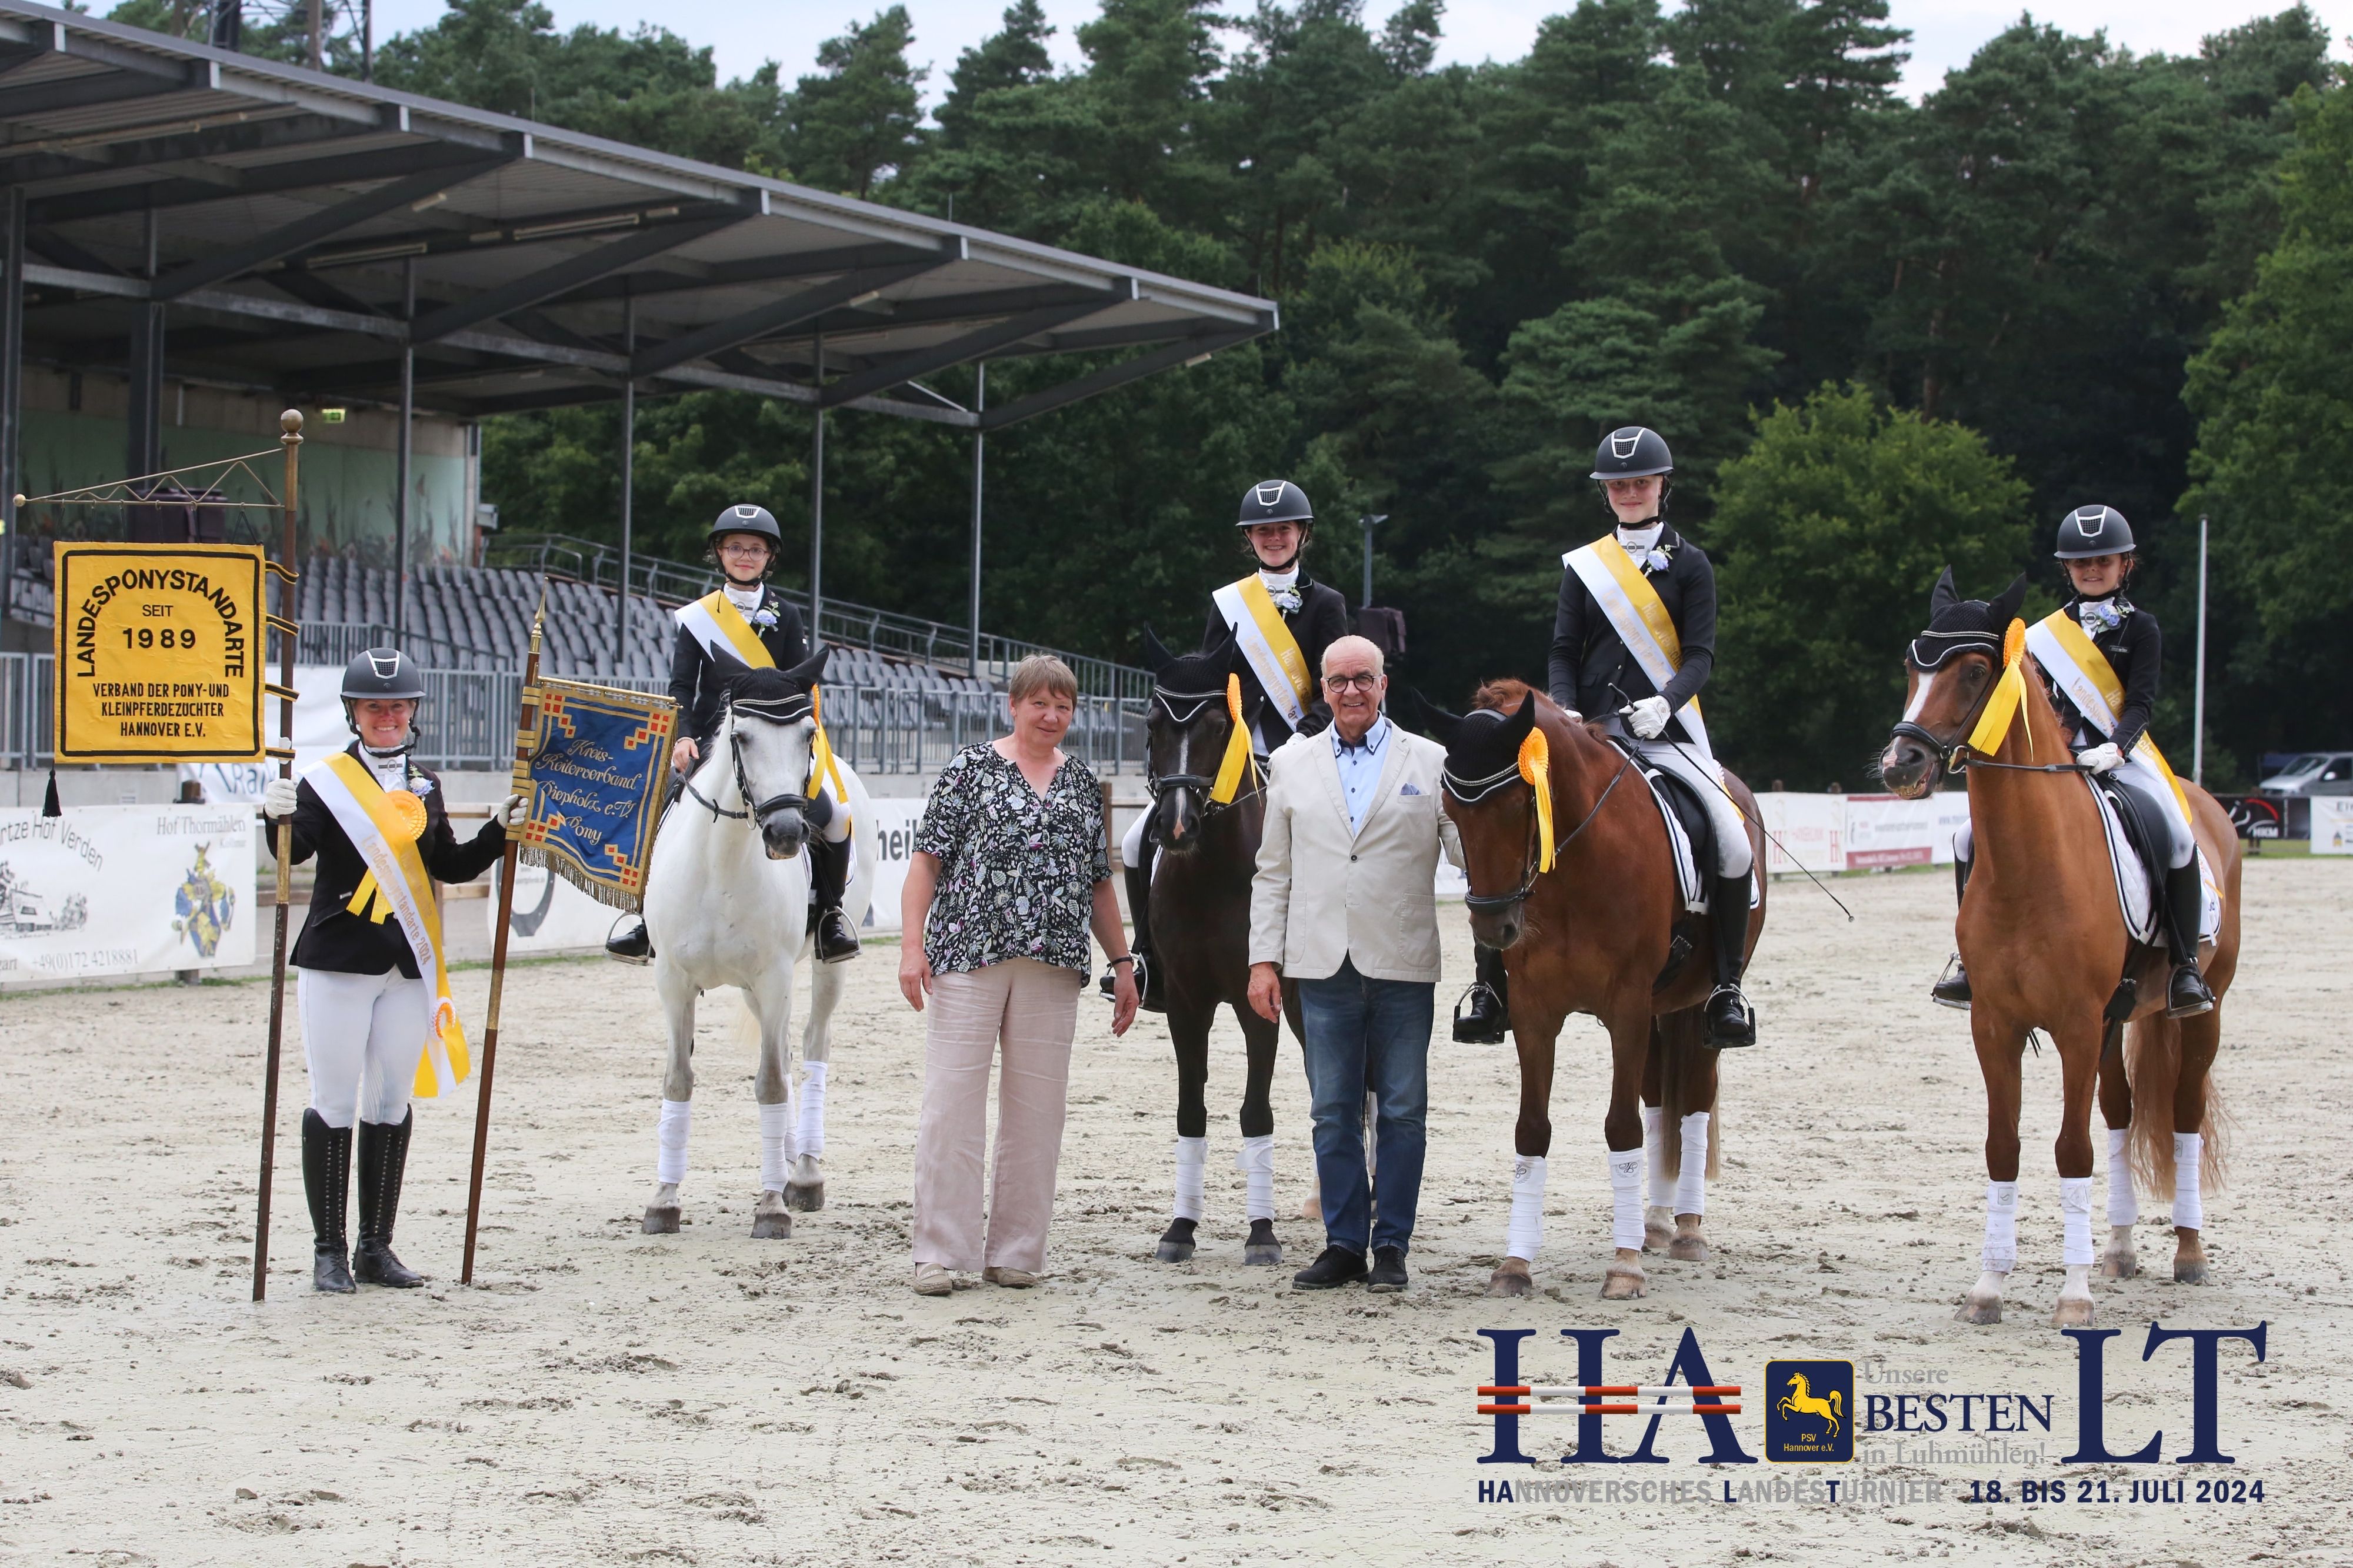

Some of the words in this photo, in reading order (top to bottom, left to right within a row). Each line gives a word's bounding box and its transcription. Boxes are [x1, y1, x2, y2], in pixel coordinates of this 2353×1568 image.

[76, 569, 244, 678] LANDESPONYSTANDARTE
[142, 604, 174, 617] SEIT
[123, 628, 196, 649] 1989
[93, 683, 144, 697] VERBAND
[148, 683, 169, 698] DER
[121, 722, 180, 736] HANNOVER
[185, 722, 206, 737] E.V.
[535, 753, 642, 790] Reiterverband
[538, 780, 601, 812] Diepholz
[156, 816, 180, 835] Hof
[565, 816, 602, 845] Pony
[32, 815, 57, 839] Hof
[61, 820, 103, 872] Verden
[415, 937, 432, 966] 2024
